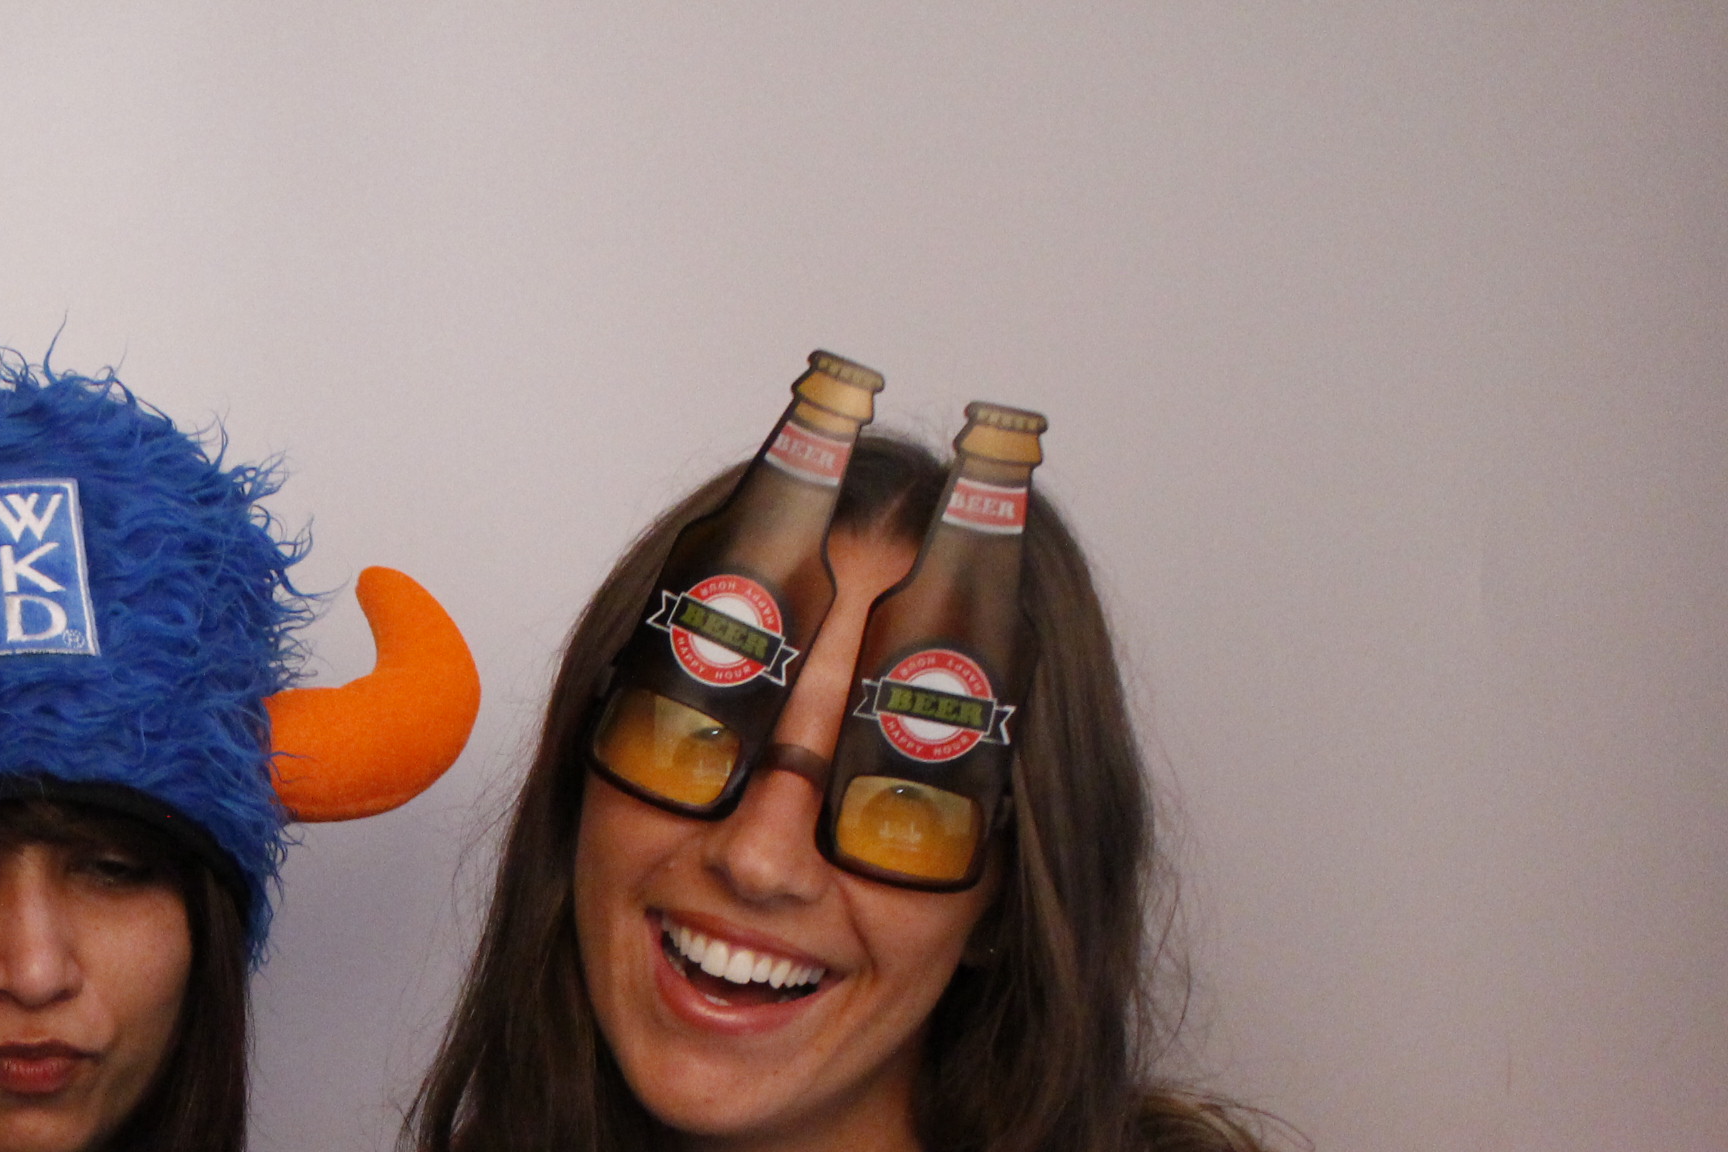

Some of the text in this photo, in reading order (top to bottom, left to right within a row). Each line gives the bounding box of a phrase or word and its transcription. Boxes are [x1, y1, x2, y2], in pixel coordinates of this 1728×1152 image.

[772, 432, 837, 470] BEER
[949, 492, 1016, 520] BEER
[679, 602, 769, 660] BEER
[676, 636, 752, 680] HAPPY HOUR
[886, 687, 984, 727] BEER
[886, 720, 970, 757] HAPPY HOUR
